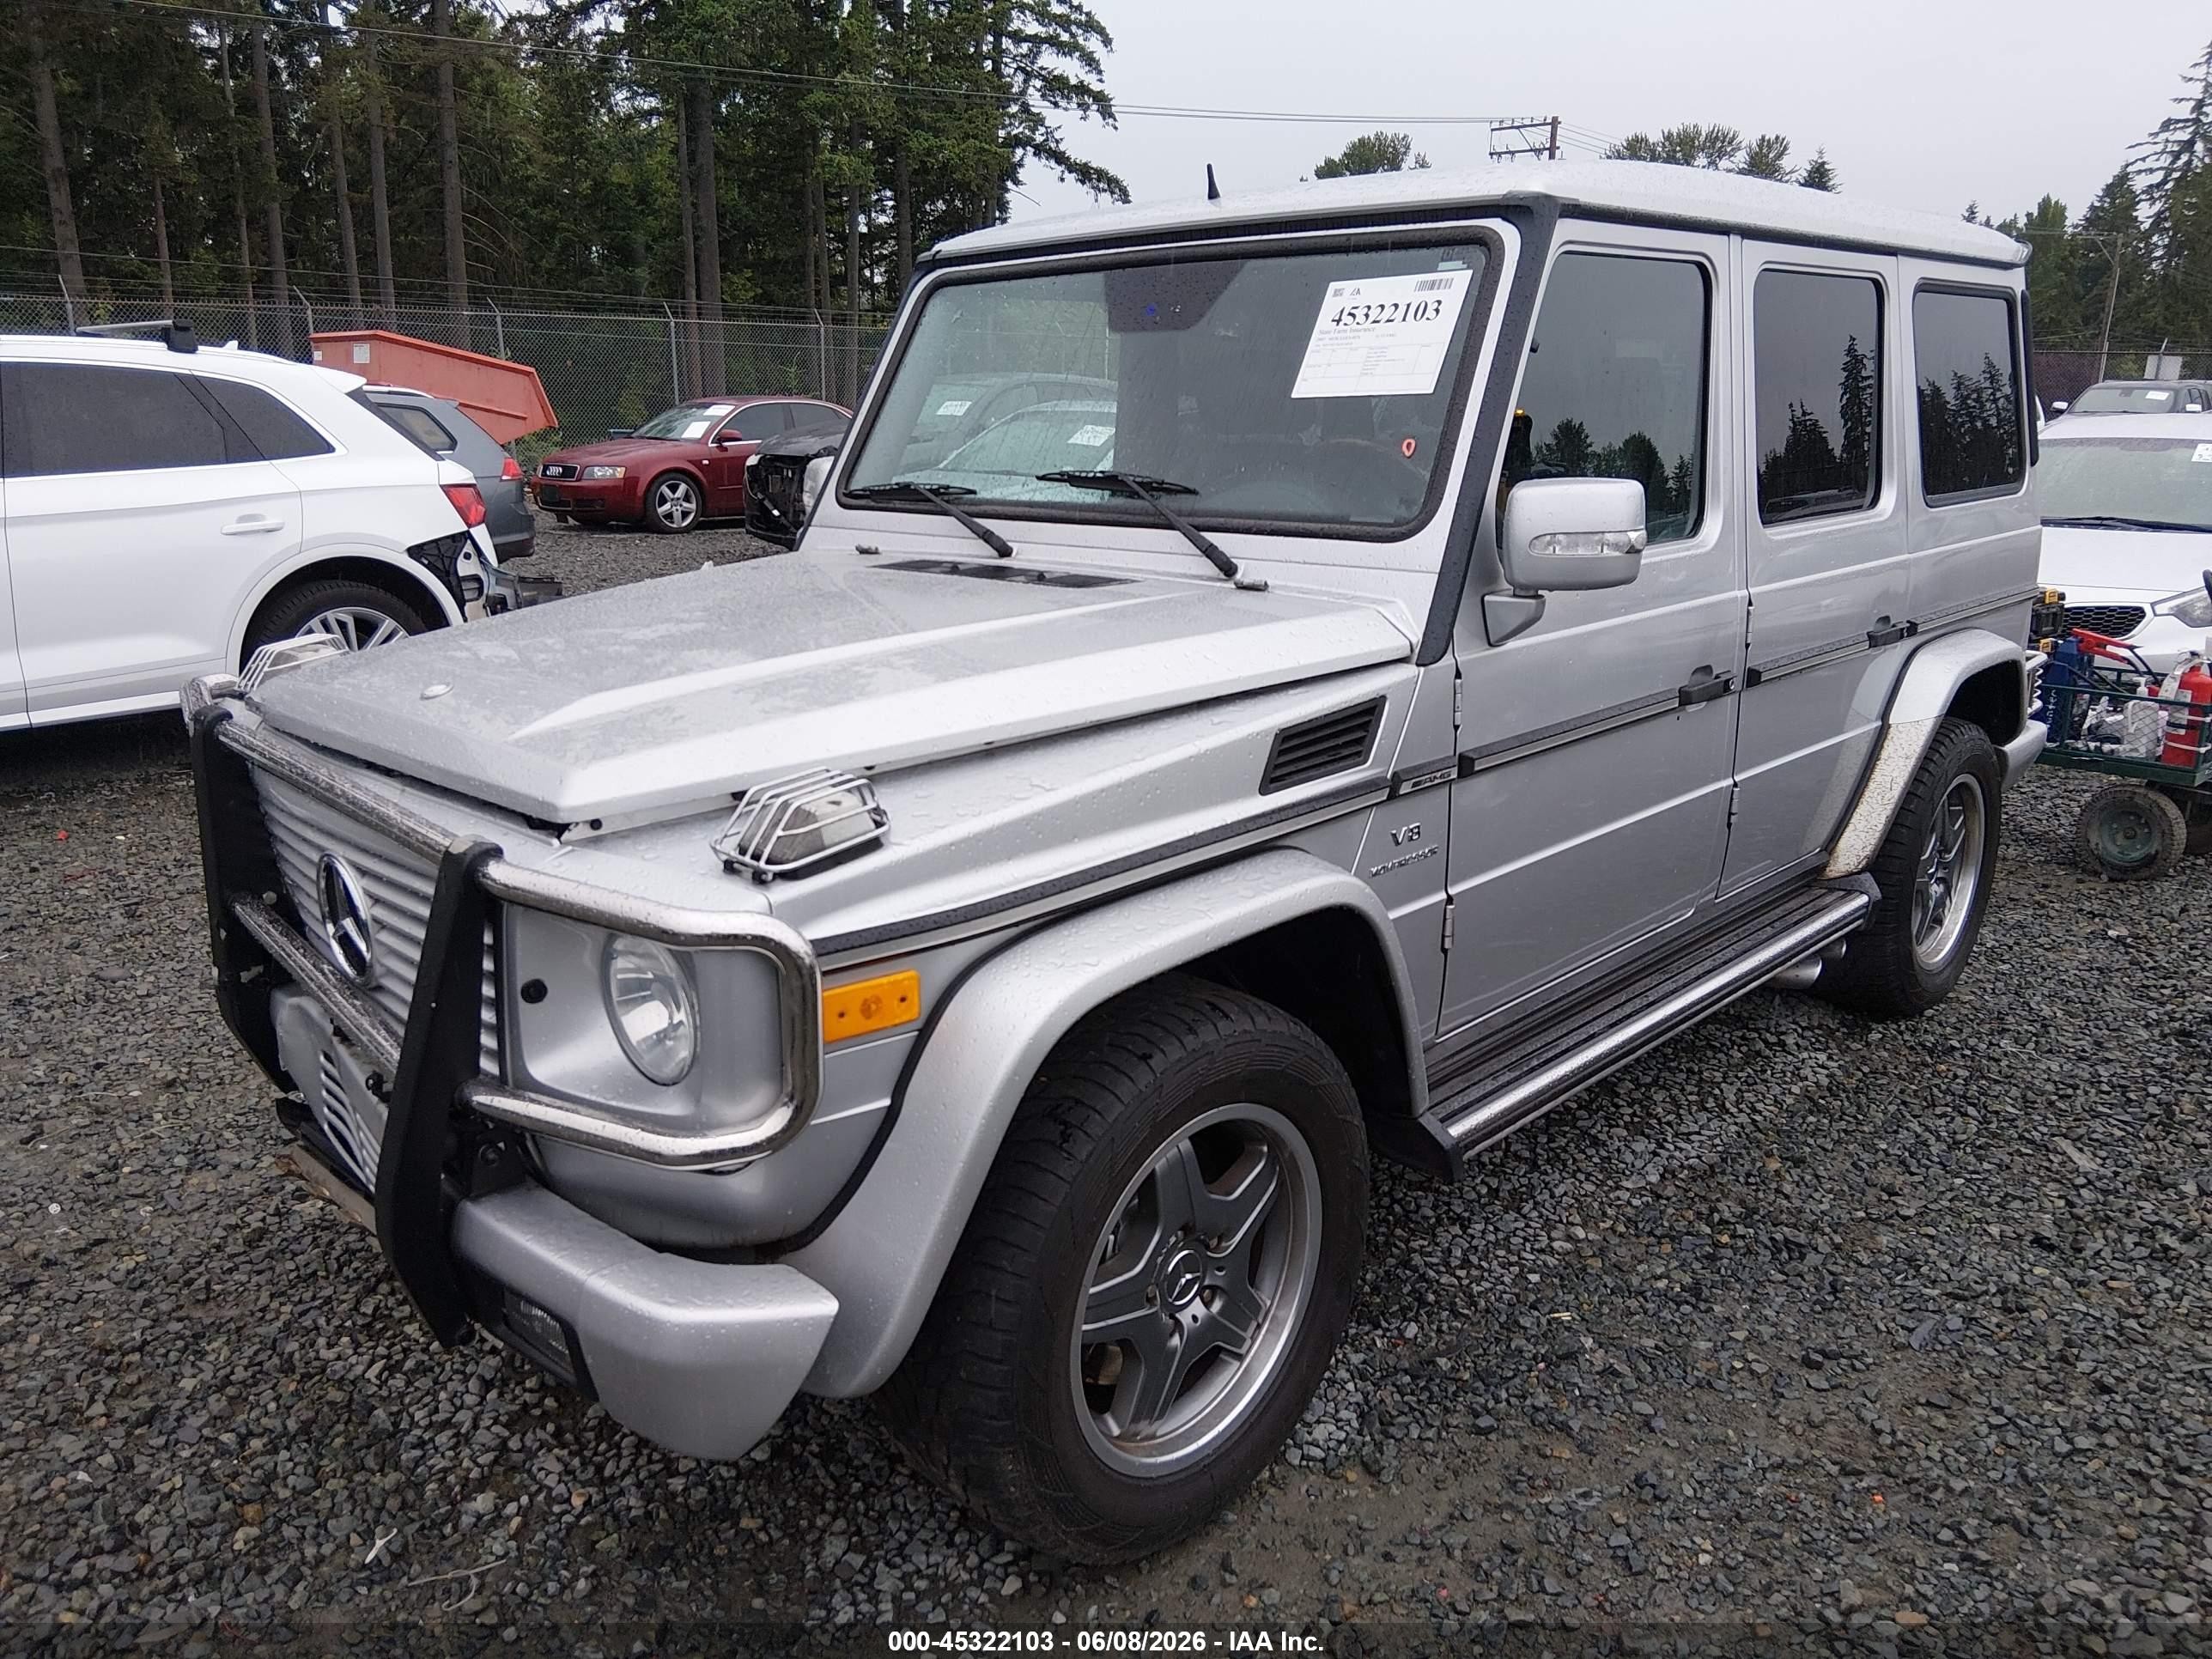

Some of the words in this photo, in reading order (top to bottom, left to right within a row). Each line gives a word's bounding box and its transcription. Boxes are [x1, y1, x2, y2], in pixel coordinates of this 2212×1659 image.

[1331, 299, 1443, 326] 45322103
[1421, 770, 1451, 785] AMG
[1389, 822, 1421, 847] V8
